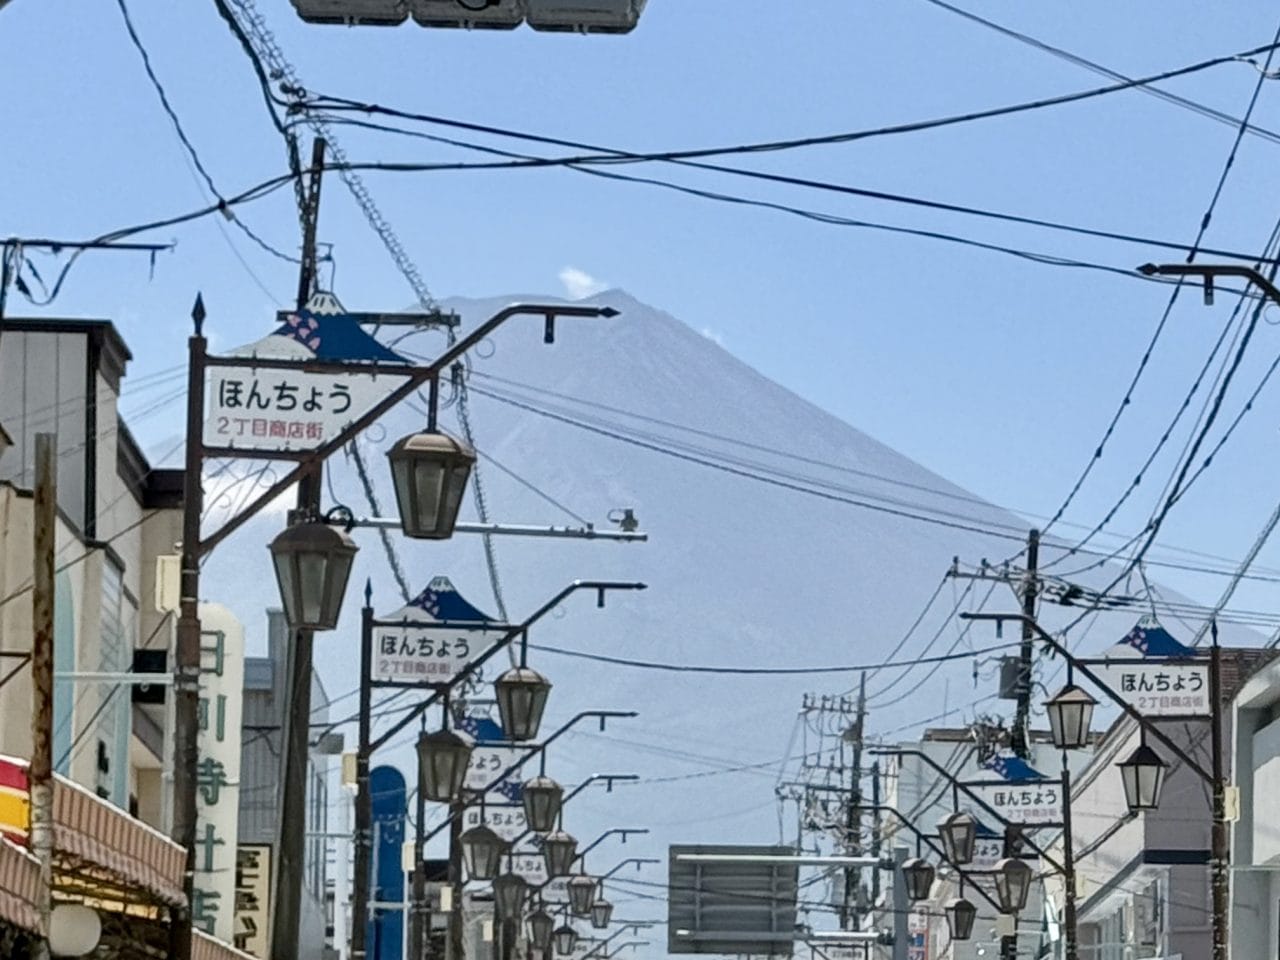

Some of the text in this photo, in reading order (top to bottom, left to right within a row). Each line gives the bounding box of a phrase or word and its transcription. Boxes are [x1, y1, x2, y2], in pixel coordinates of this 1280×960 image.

[219, 379, 351, 414] ほんちょう
[217, 416, 324, 440] 2丁目商店街
[381, 635, 470, 659] ほんちょう
[1121, 672, 1203, 692] ほんちょう
[994, 789, 1057, 806] ほんちょう
